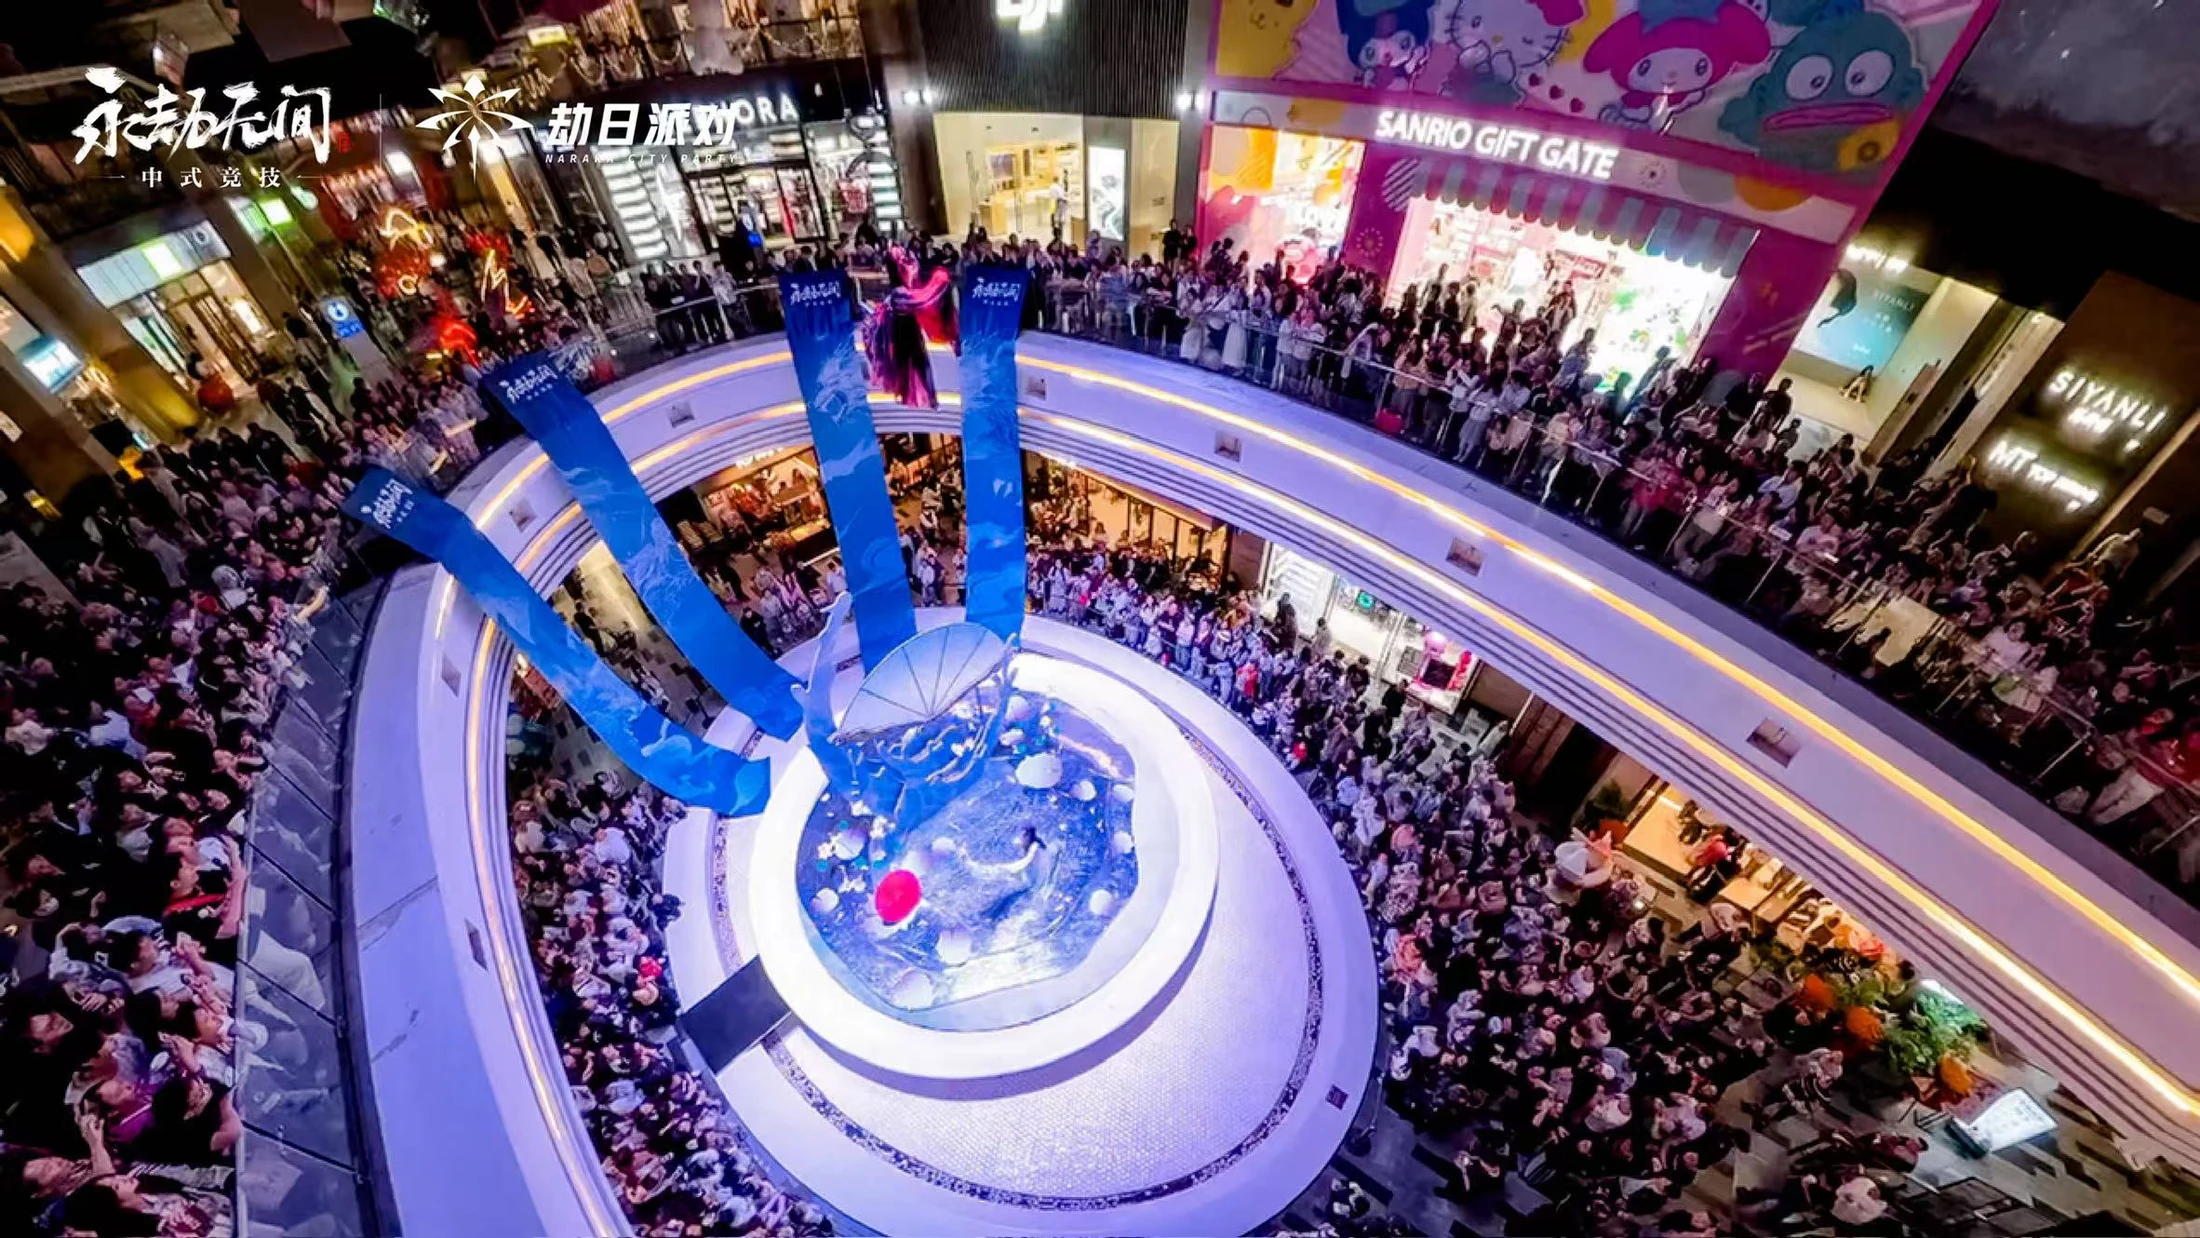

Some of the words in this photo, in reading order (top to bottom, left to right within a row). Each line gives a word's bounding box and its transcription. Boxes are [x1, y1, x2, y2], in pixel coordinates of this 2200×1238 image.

[1375, 109, 1472, 150] SANRIO
[1474, 125, 1540, 163] GIFT
[1538, 136, 1620, 180] GATE
[2048, 370, 2167, 433] SIYANLI
[1987, 440, 2039, 473] MT
